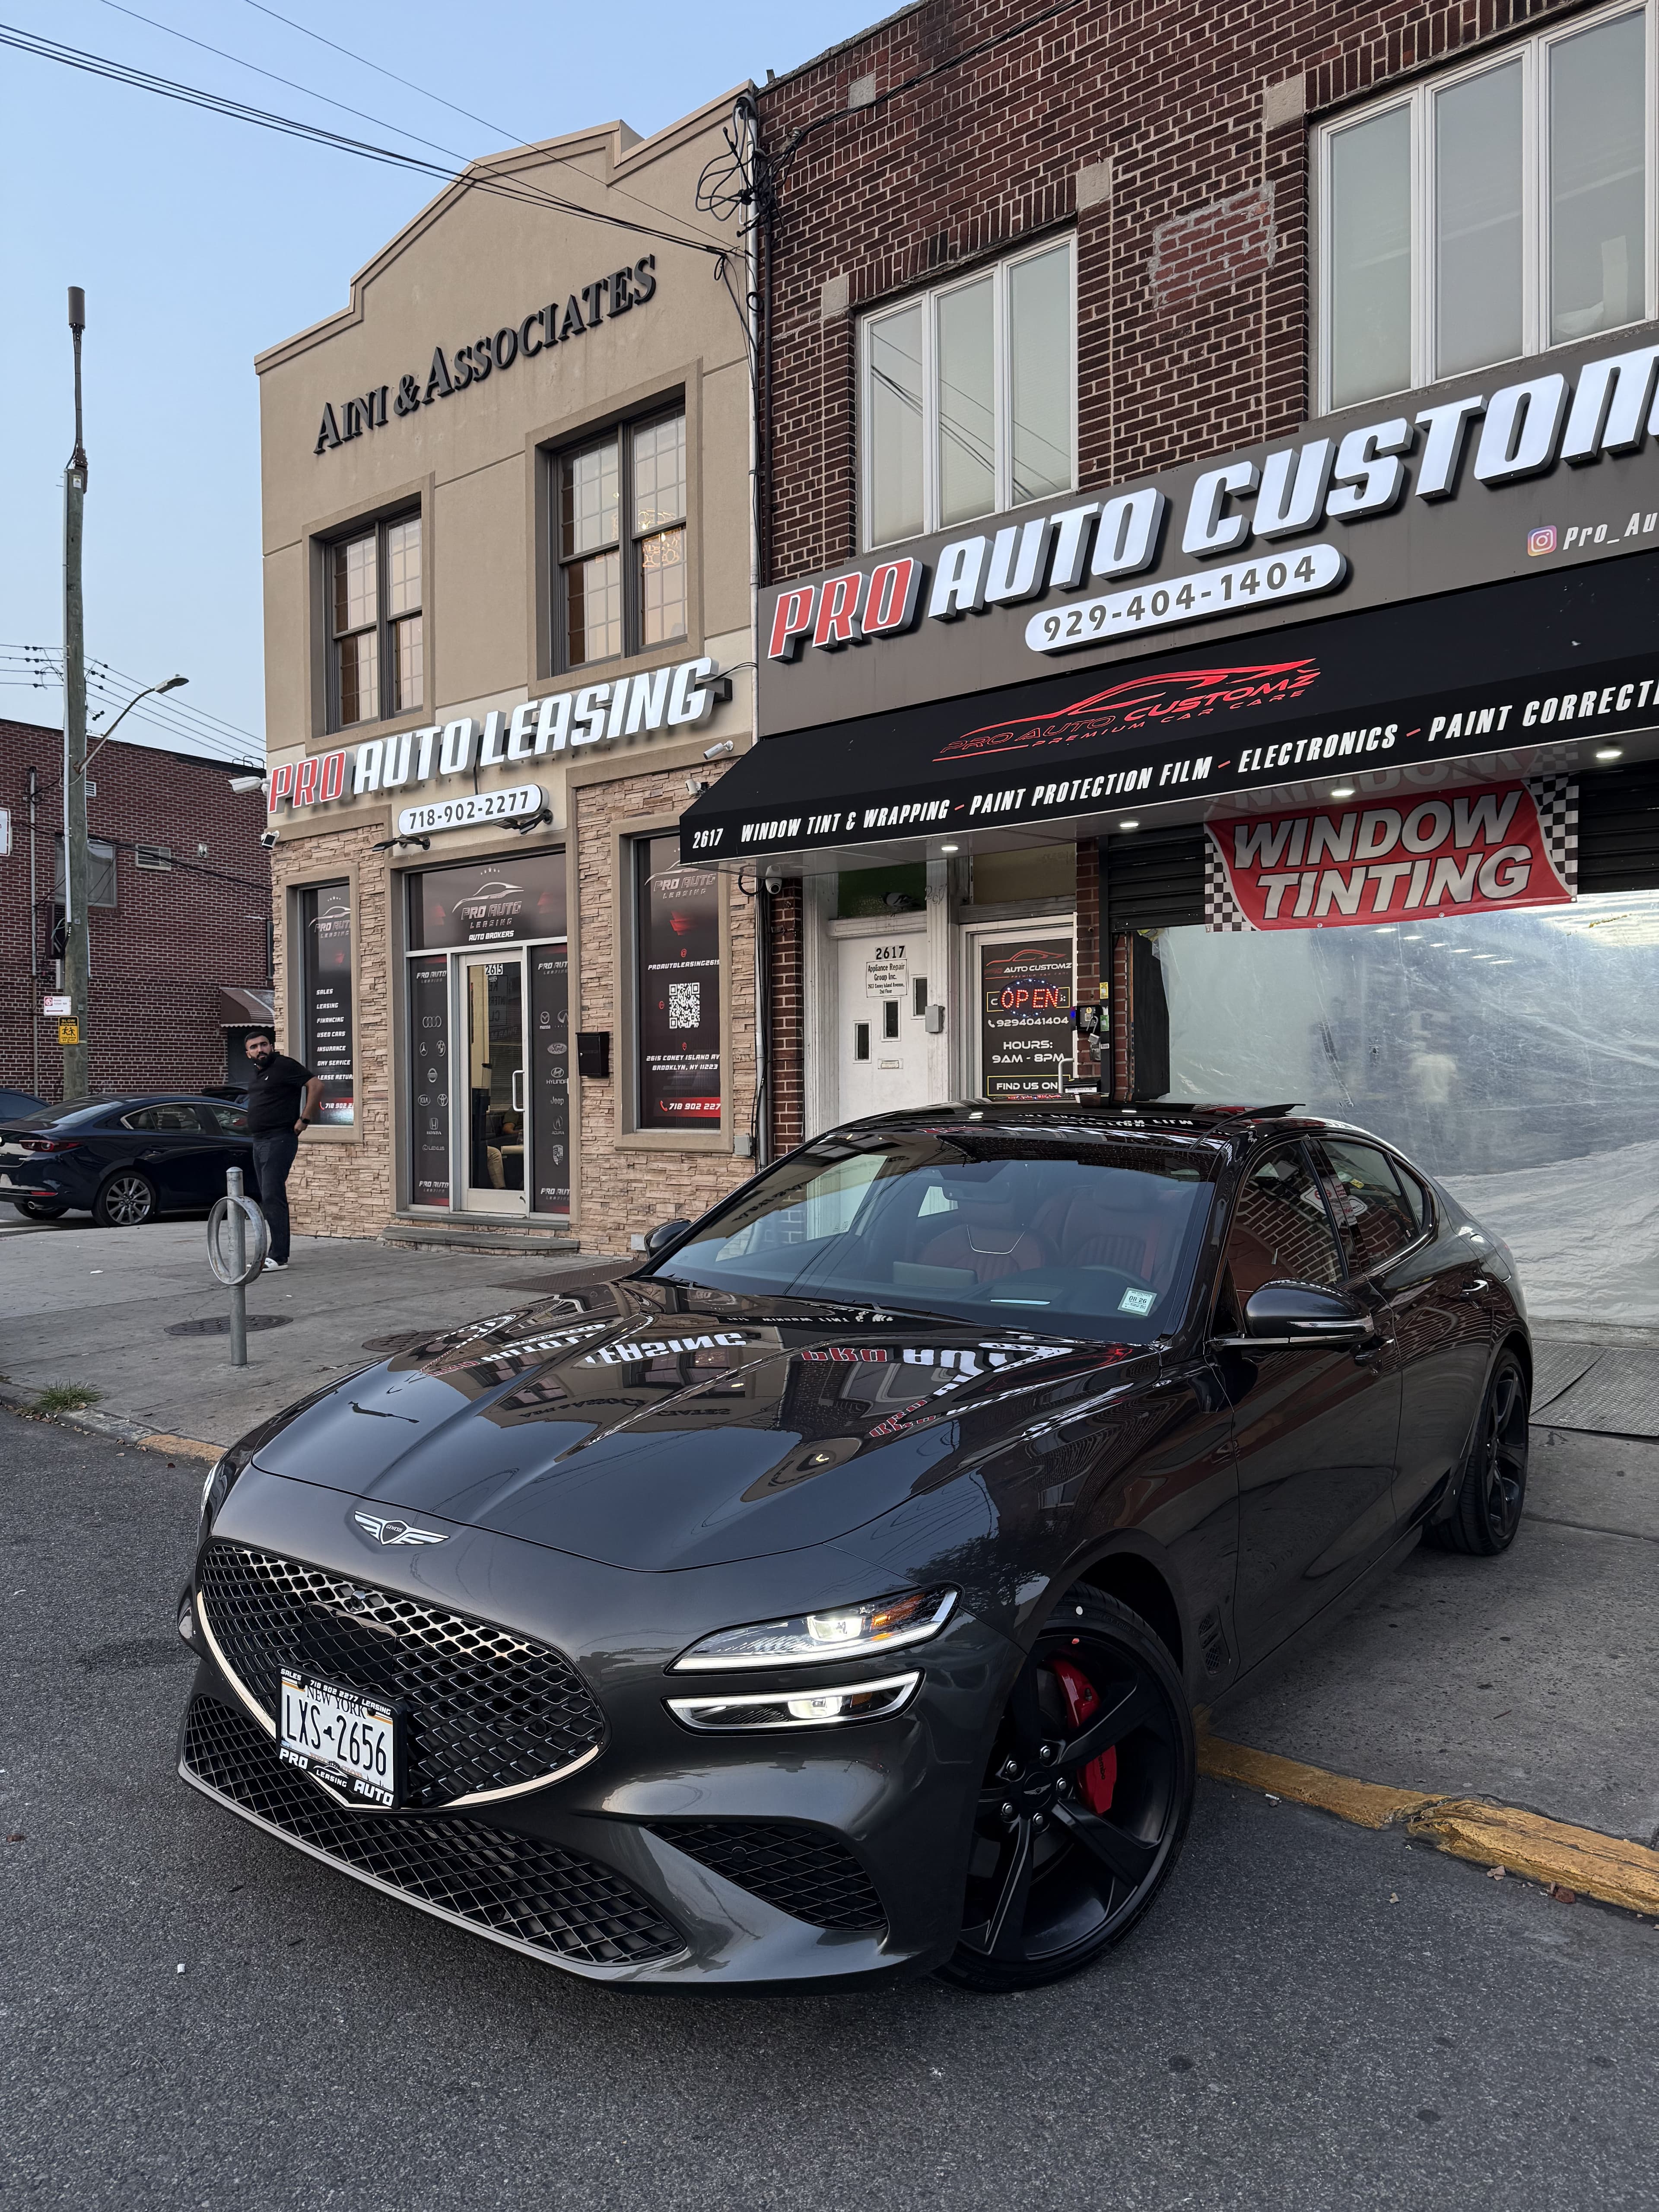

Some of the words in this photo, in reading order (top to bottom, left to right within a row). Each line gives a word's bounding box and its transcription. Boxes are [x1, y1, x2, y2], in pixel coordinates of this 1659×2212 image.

[313, 385, 389, 454] AINI
[392, 374, 421, 416] &
[422, 254, 656, 404] ASSOCIATES
[768, 556, 922, 662] PRO
[928, 487, 1165, 620] AUTO
[1182, 345, 1659, 557] CUSTOM
[1043, 554, 1316, 642] 929-404-1404
[1032, 721, 1146, 747] PREMIUM
[1160, 708, 1215, 724] CAR
[1230, 690, 1304, 709] CARE
[268, 749, 353, 814] PRO
[353, 718, 479, 795] AUTO
[480, 657, 718, 768] LEASING
[940, 732, 1014, 753] PRO
[1014, 715, 1116, 742] AUTO
[692, 828, 724, 849] 2617
[741, 818, 801, 843] WINDOW
[807, 813, 842, 835] TINT
[864, 799, 950, 829] WRAPPING
[969, 788, 1027, 816] PAINT
[1032, 766, 1153, 807] PROTECTION
[1159, 756, 1213, 787] FILM
[1237, 723, 1398, 774] ELECTRONICS
[1428, 705, 1513, 743] PAINT
[409, 790, 529, 830] 718-902-2277
[1233, 790, 1526, 870] WINDOW
[653, 878, 680, 891] PRO
[681, 874, 717, 888] AUTO
[1258, 843, 1532, 921] TINTING
[663, 888, 706, 899] LEASING
[461, 906, 486, 920] PRO
[488, 901, 522, 917] AUTO
[333, 920, 350, 930] AUT
[470, 918, 512, 929] LEASING
[469, 933, 484, 941] AUTO
[485, 930, 514, 940] BROKERS
[876, 945, 905, 960] 2617
[486, 964, 502, 975] 2615
[868, 964, 888, 973] Appliance
[890, 963, 905, 971] Repair
[1029, 963, 1072, 971] CUSTOMZ
[874, 974, 887, 982] Group
[1001, 988, 1059, 1008] OPEN
[996, 1017, 1069, 1027] 9294041404
[1003, 1040, 1053, 1050] HOURS:
[992, 1054, 1023, 1064] 9AM
[1034, 1053, 1065, 1062] 8PM
[997, 1082, 1020, 1090] FIND
[1041, 1081, 1058, 1090] ON
[386, 1524, 403, 1532] GENESIS
[280, 1669, 302, 1681] SALES
[306, 1686, 331, 1706] NEW
[336, 1697, 367, 1719] YORK
[310, 1680, 321, 1689] 718
[323, 1685, 337, 1695] 902
[339, 1691, 359, 1702] 2277
[362, 1699, 391, 1715] LEASING
[286, 1694, 321, 1750] LXS
[336, 1715, 386, 1776] 2656
[279, 1748, 308, 1770] PRO
[353, 1779, 394, 1807] AUTO
[316, 1770, 347, 1787] LEASING
